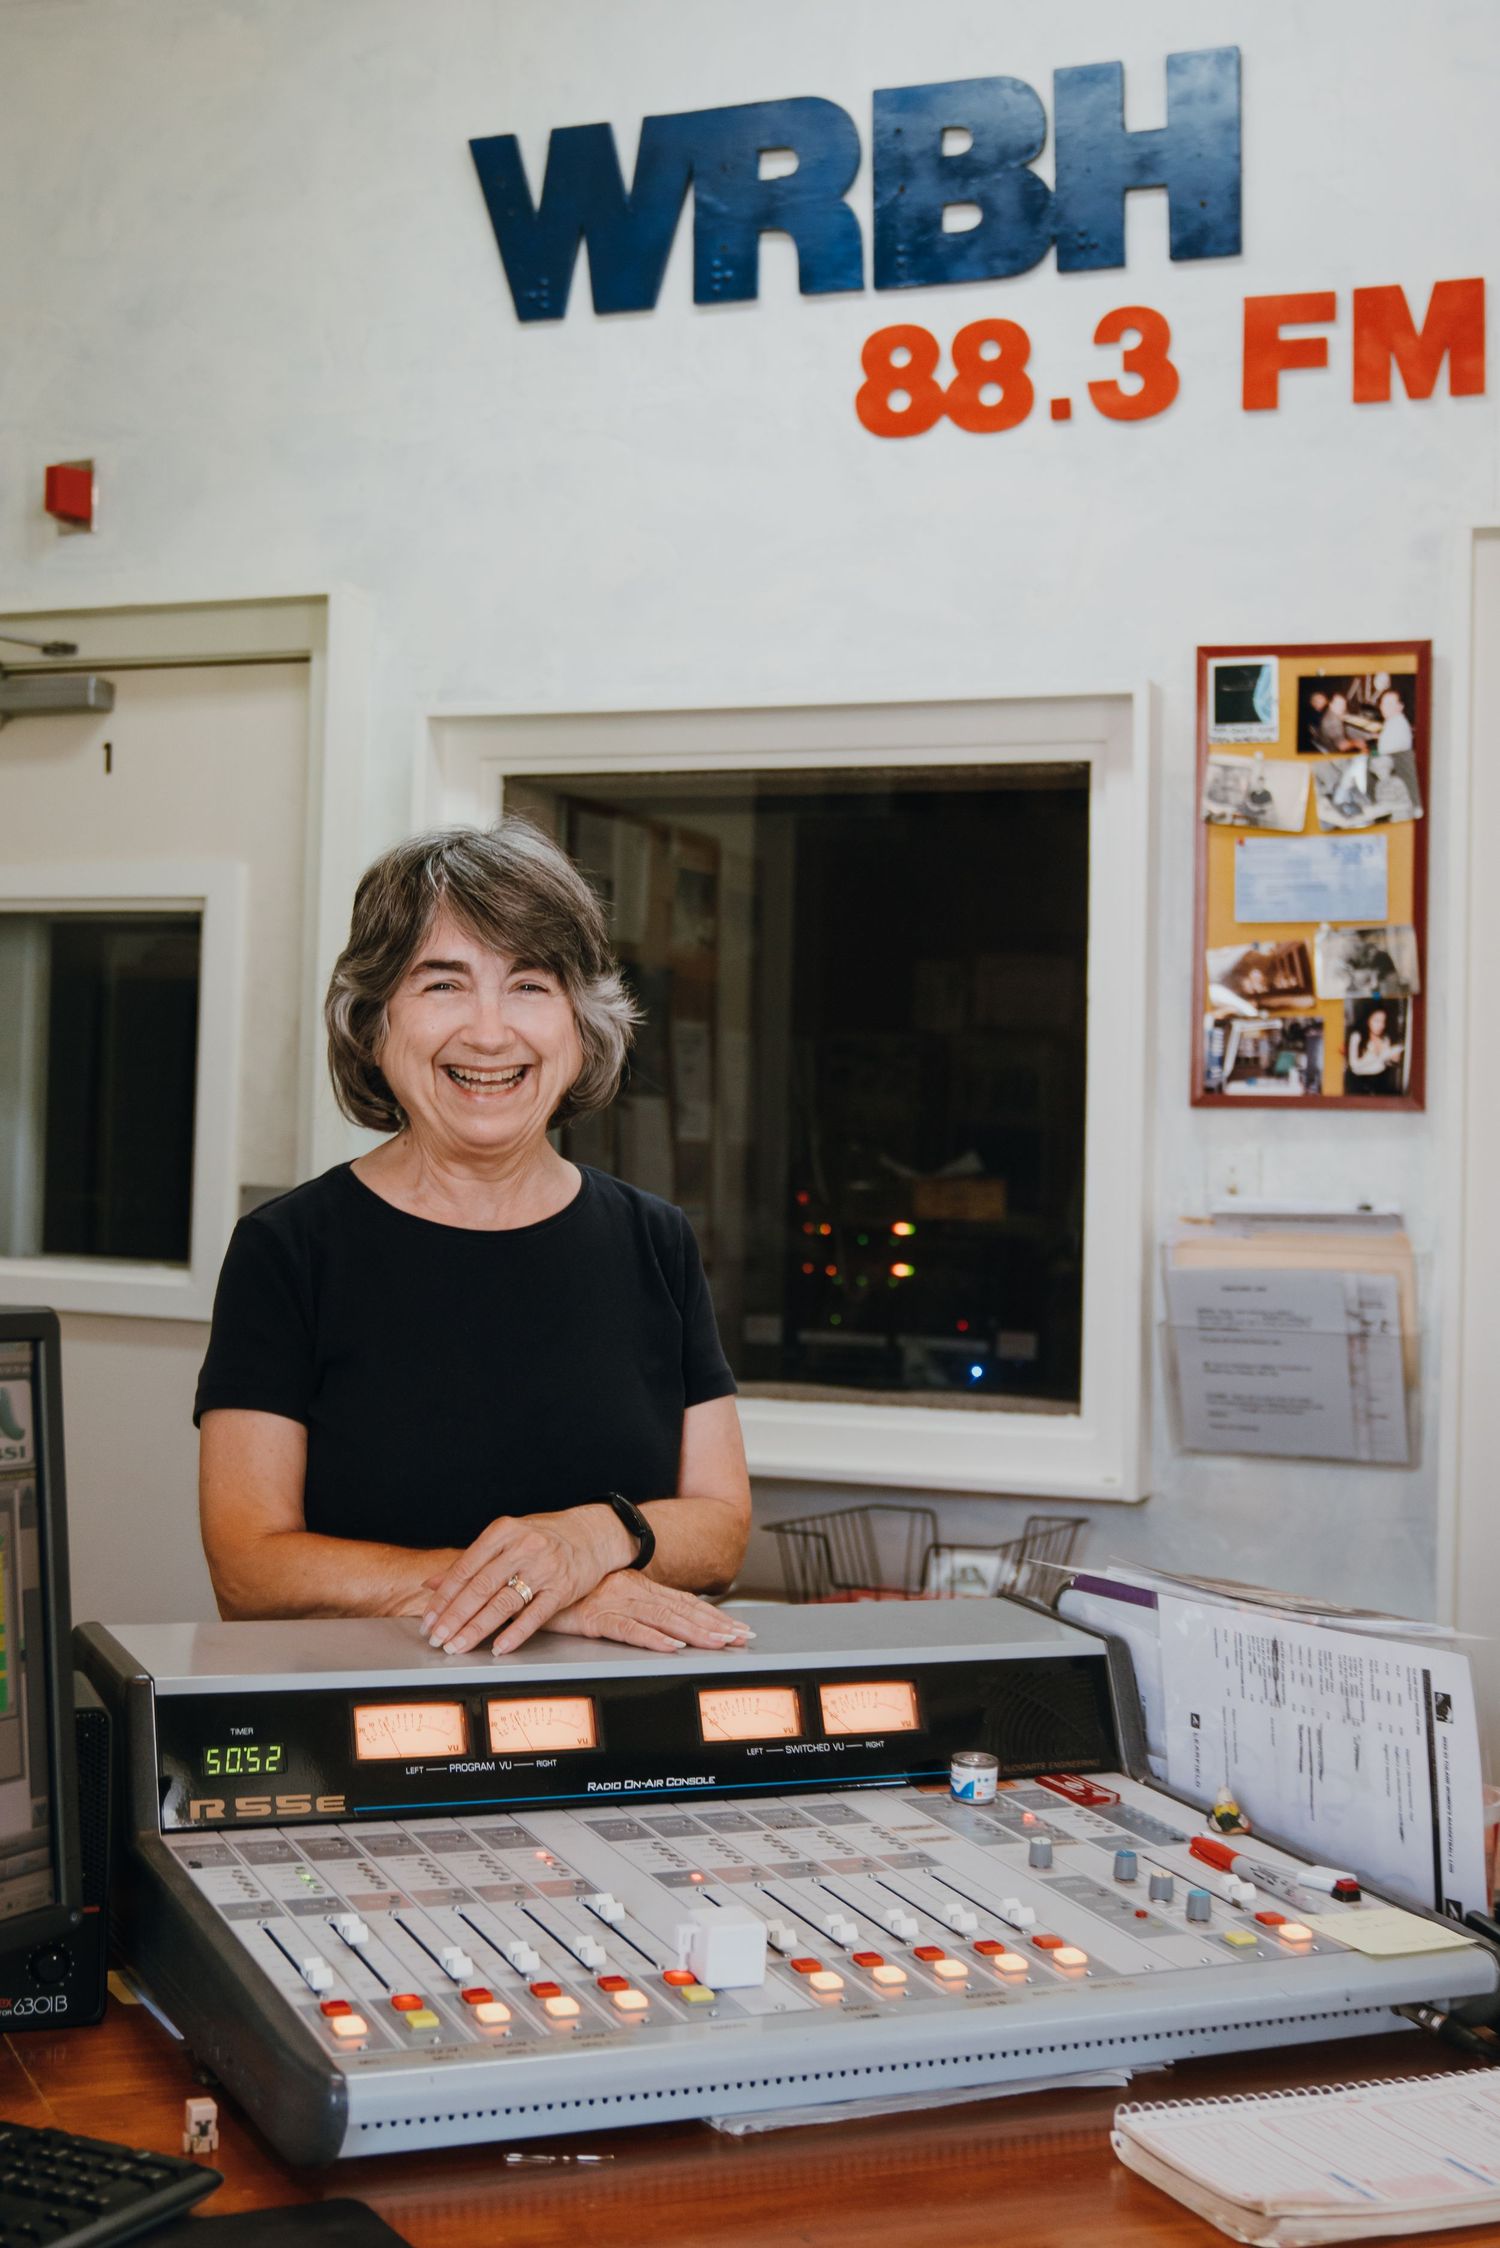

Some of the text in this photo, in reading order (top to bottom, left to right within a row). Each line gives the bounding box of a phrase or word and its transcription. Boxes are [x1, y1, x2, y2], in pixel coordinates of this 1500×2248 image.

[468, 45, 1242, 323] WRBH
[855, 277, 1487, 438] 88.3 FM
[230, 1727, 254, 1736] TIMER
[747, 1740, 885, 1756] LEFT SWITCHED VU RIGHT
[406, 1759, 557, 1775] LEFT PROGRAM VU RIGHT
[13, 1995, 68, 2016] 6301B
